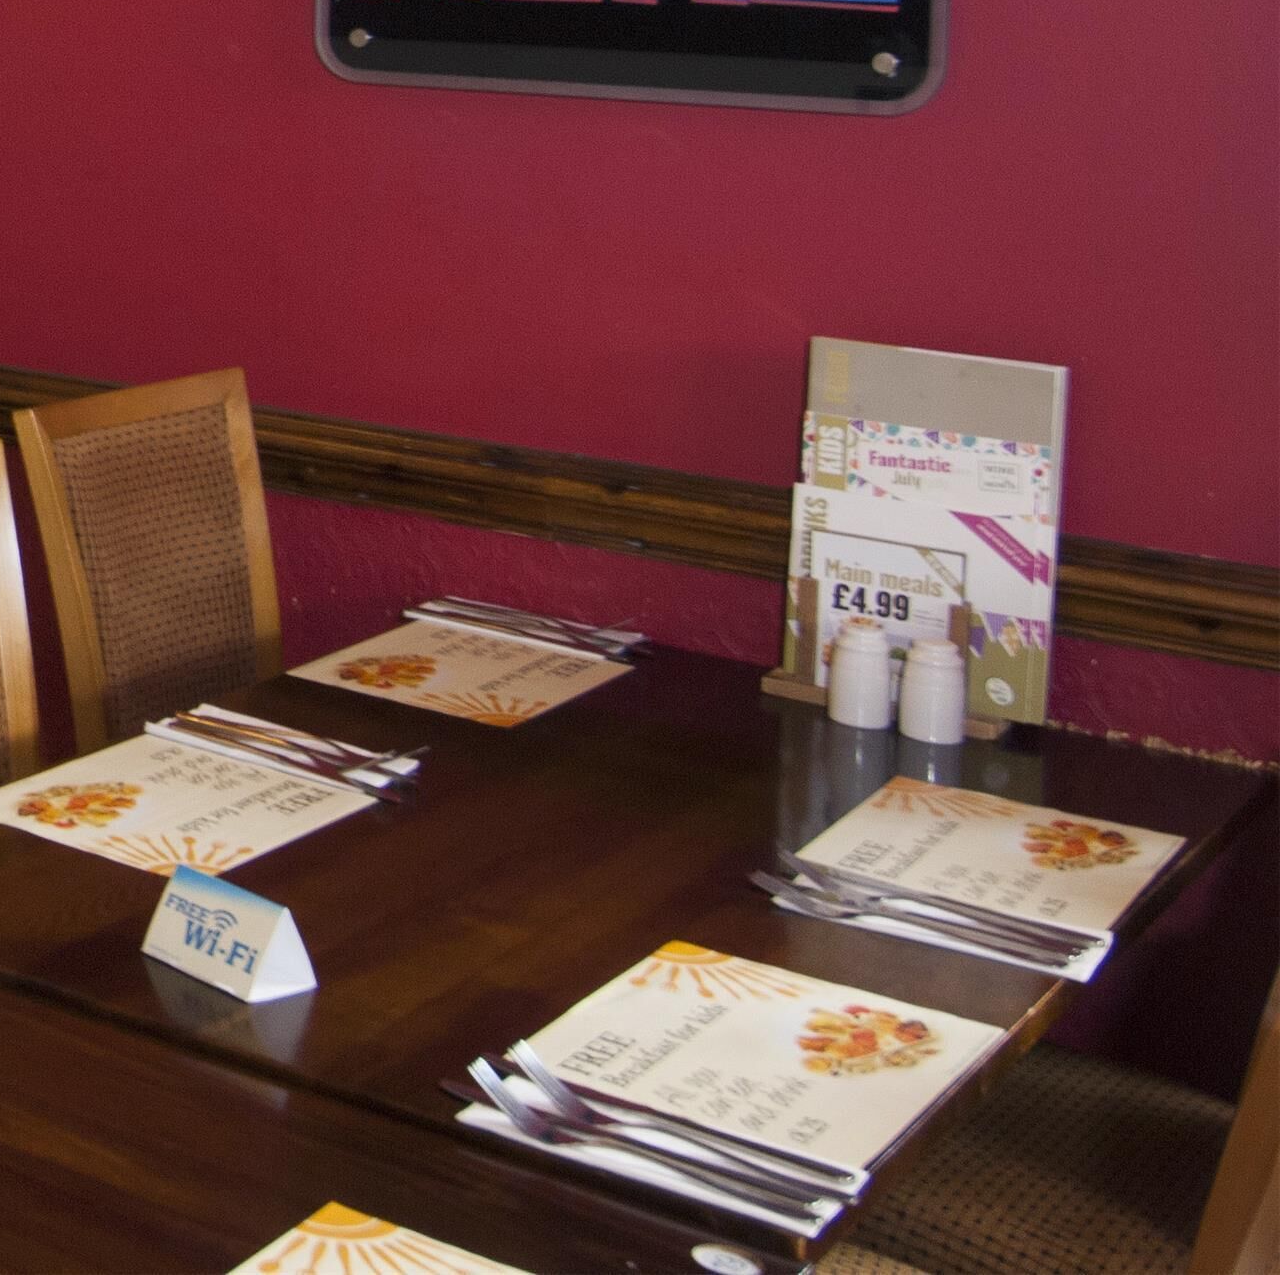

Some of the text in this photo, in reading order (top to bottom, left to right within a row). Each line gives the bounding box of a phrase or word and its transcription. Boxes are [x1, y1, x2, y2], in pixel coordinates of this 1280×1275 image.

[816, 426, 846, 474] KIDS
[868, 450, 952, 474] Fantastic
[891, 472, 923, 489] July
[824, 558, 873, 585] Main
[879, 571, 944, 598] meals
[832, 583, 910, 622] £4.99
[165, 892, 210, 924] FREE
[183, 919, 259, 975] Wi-Fi
[559, 1029, 636, 1076] FREE
